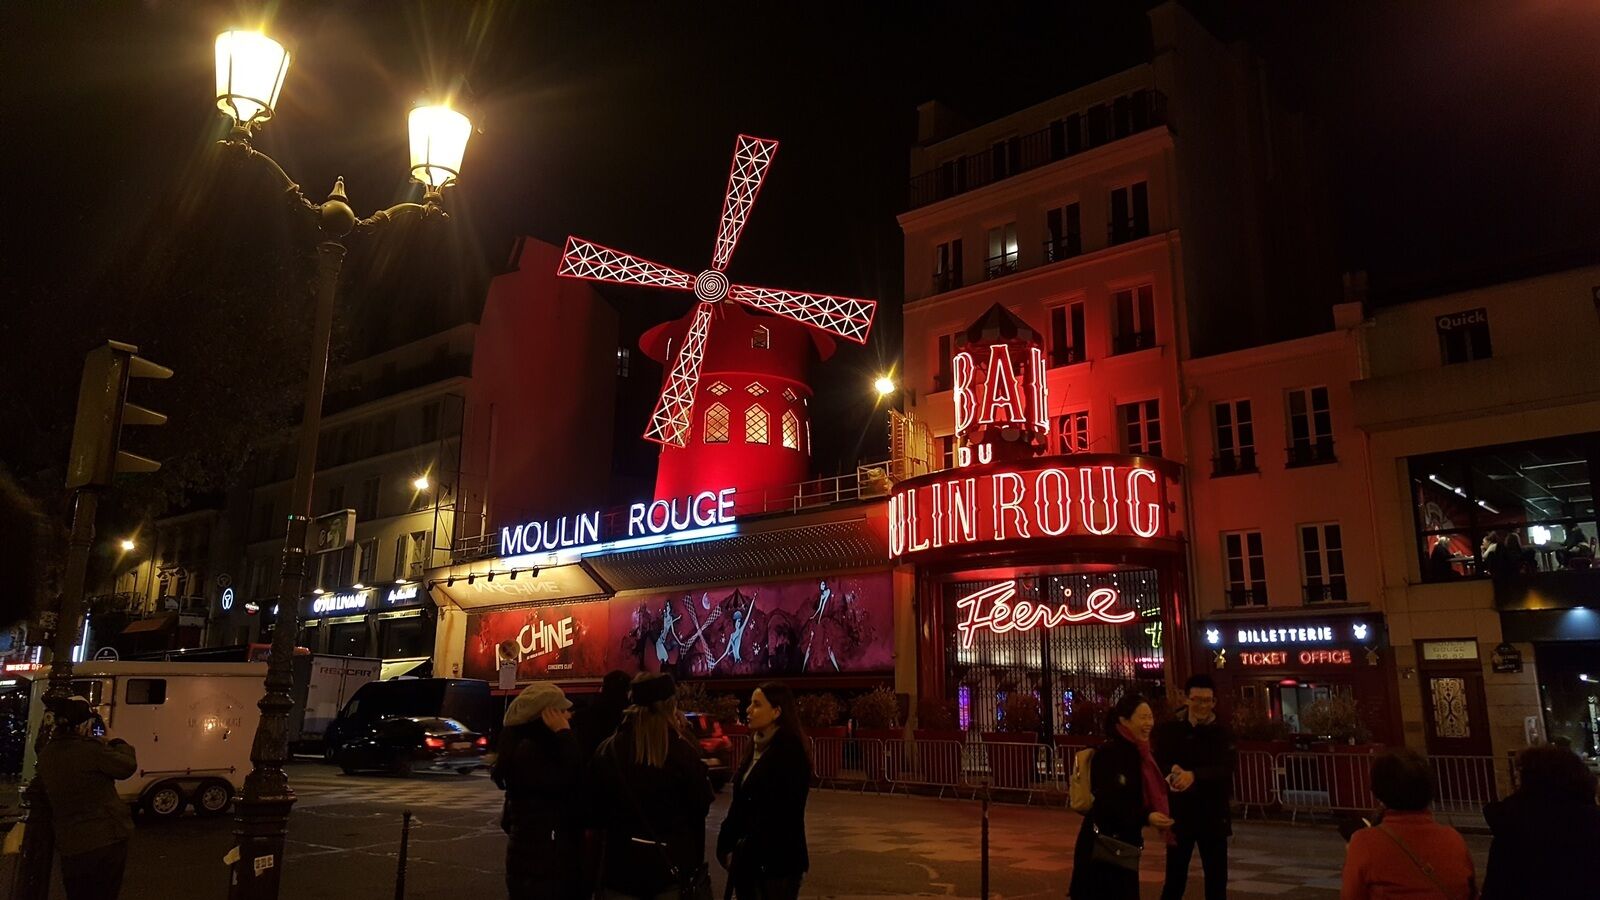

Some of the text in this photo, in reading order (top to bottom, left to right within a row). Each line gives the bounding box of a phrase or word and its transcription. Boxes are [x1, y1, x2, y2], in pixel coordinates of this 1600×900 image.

[1437, 310, 1487, 330] Quick
[952, 343, 1050, 438] BAL
[958, 443, 993, 467] DU
[501, 487, 737, 556] MOULIN ROUGE
[992, 466, 1160, 539] ROUG
[956, 580, 1135, 649] Féerie
[1238, 626, 1333, 643] BILLETTERIE
[1239, 650, 1352, 665] TICKET OFFICE
